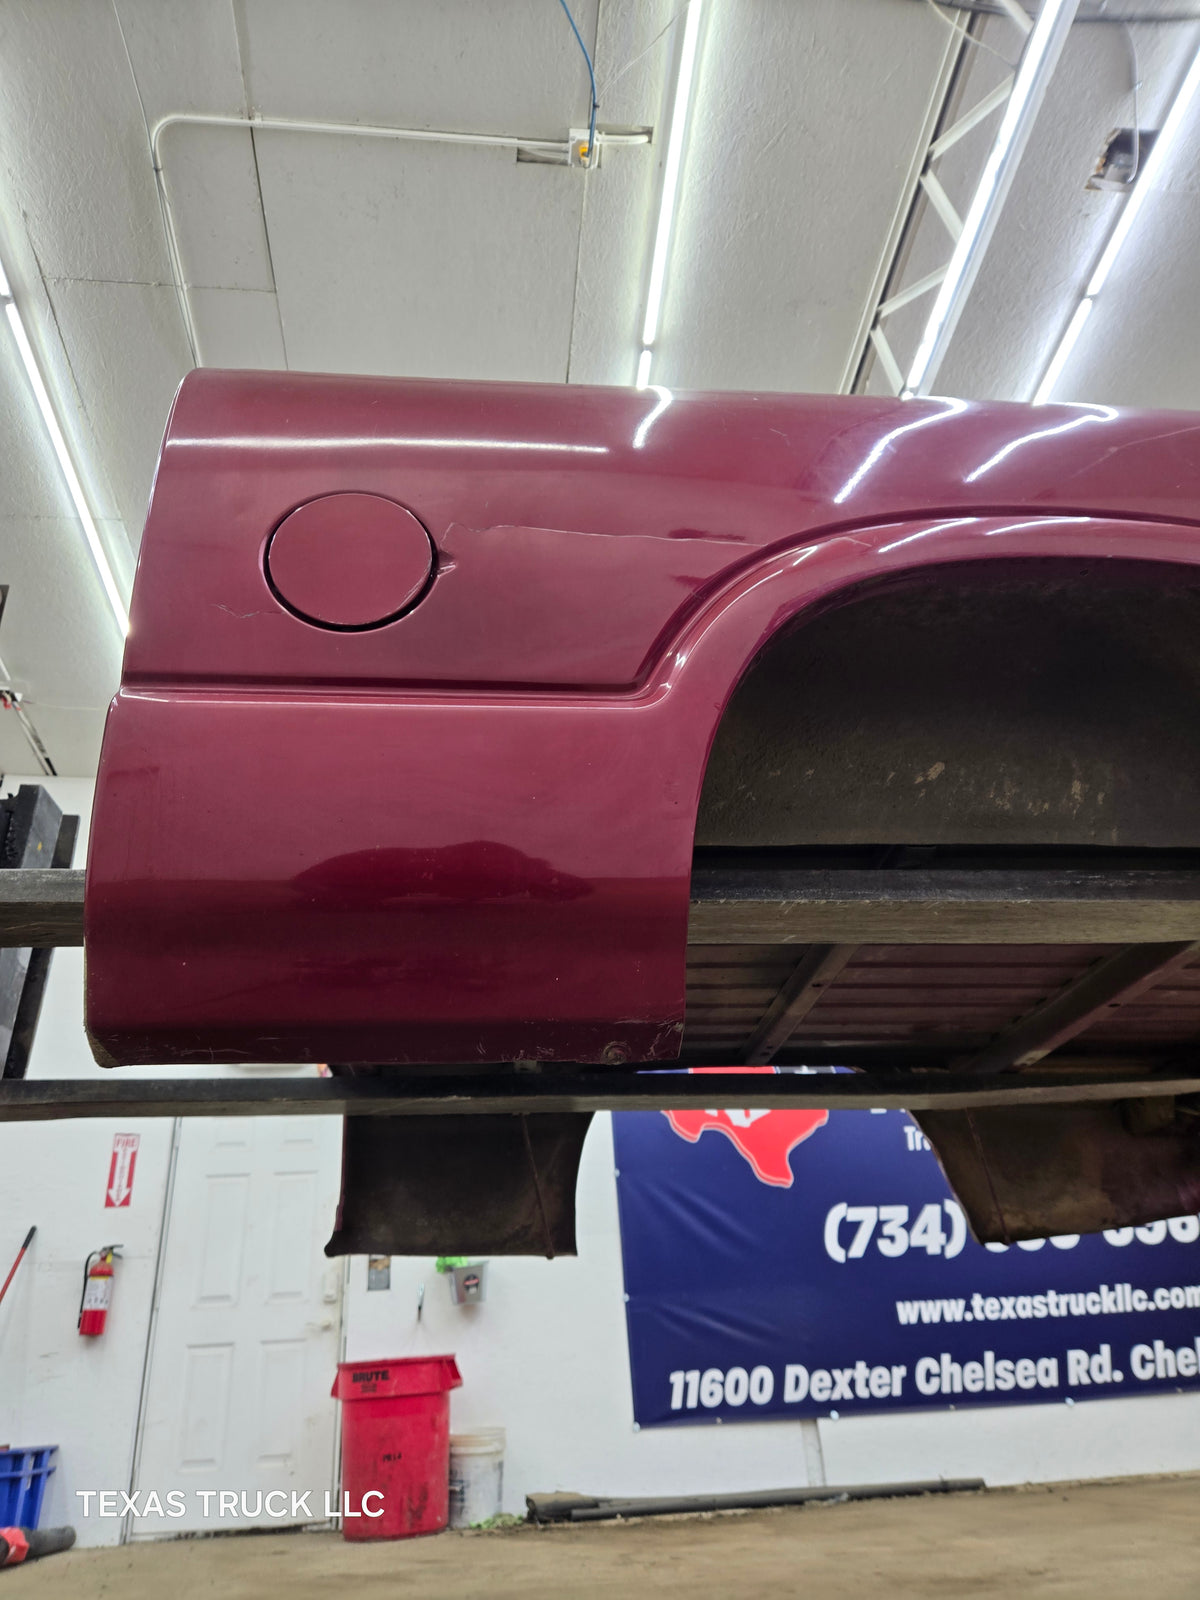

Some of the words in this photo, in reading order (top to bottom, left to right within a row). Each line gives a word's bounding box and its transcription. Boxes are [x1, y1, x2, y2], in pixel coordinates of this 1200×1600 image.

[824, 1199, 967, 1263] (734)
[352, 1370, 389, 1382] BRUTE
[669, 1365, 774, 1409] 11600
[783, 1360, 907, 1402] Dexter
[915, 1350, 1059, 1395] Chelsea
[1066, 1343, 1124, 1386] Rd.
